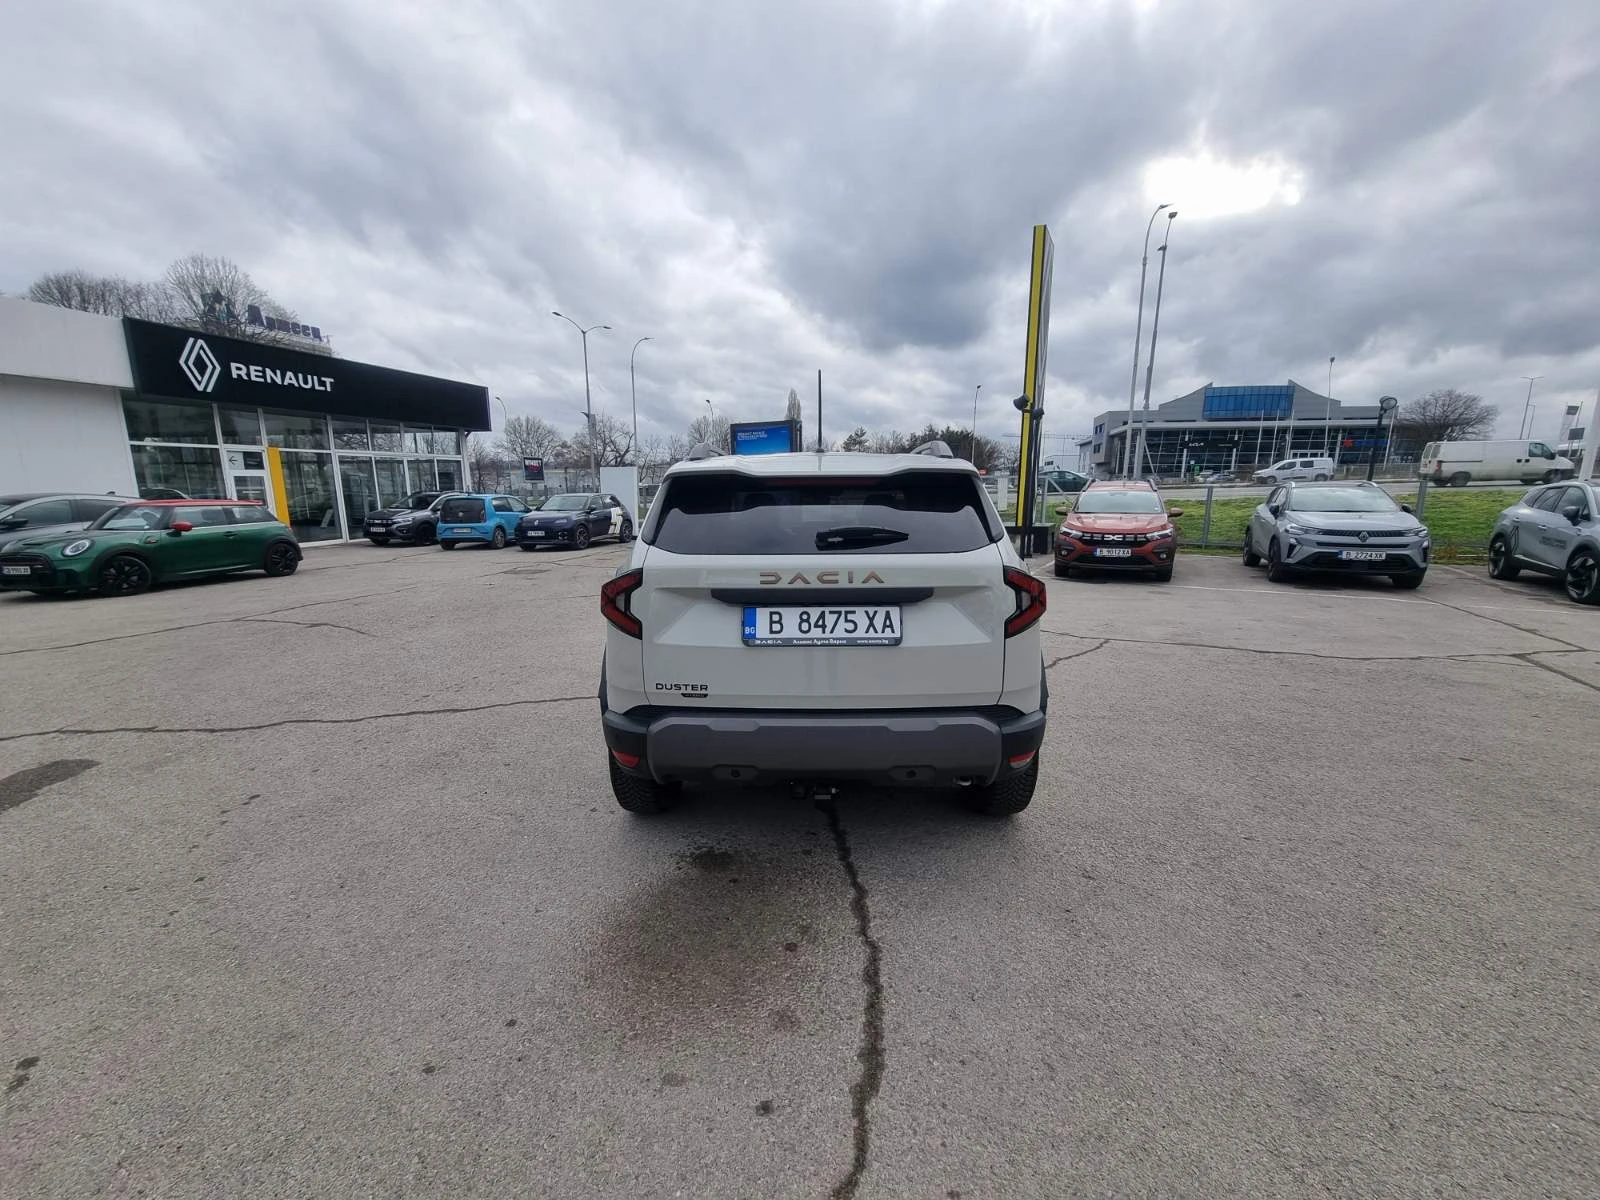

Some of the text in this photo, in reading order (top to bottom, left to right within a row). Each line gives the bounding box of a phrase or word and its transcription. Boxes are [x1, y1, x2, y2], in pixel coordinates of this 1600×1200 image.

[230, 361, 335, 392] RENAULT
[759, 571, 885, 585] DACIA
[769, 610, 896, 635] B 8475 XA
[744, 626, 756, 635] BG
[655, 683, 709, 691] DUSTER
